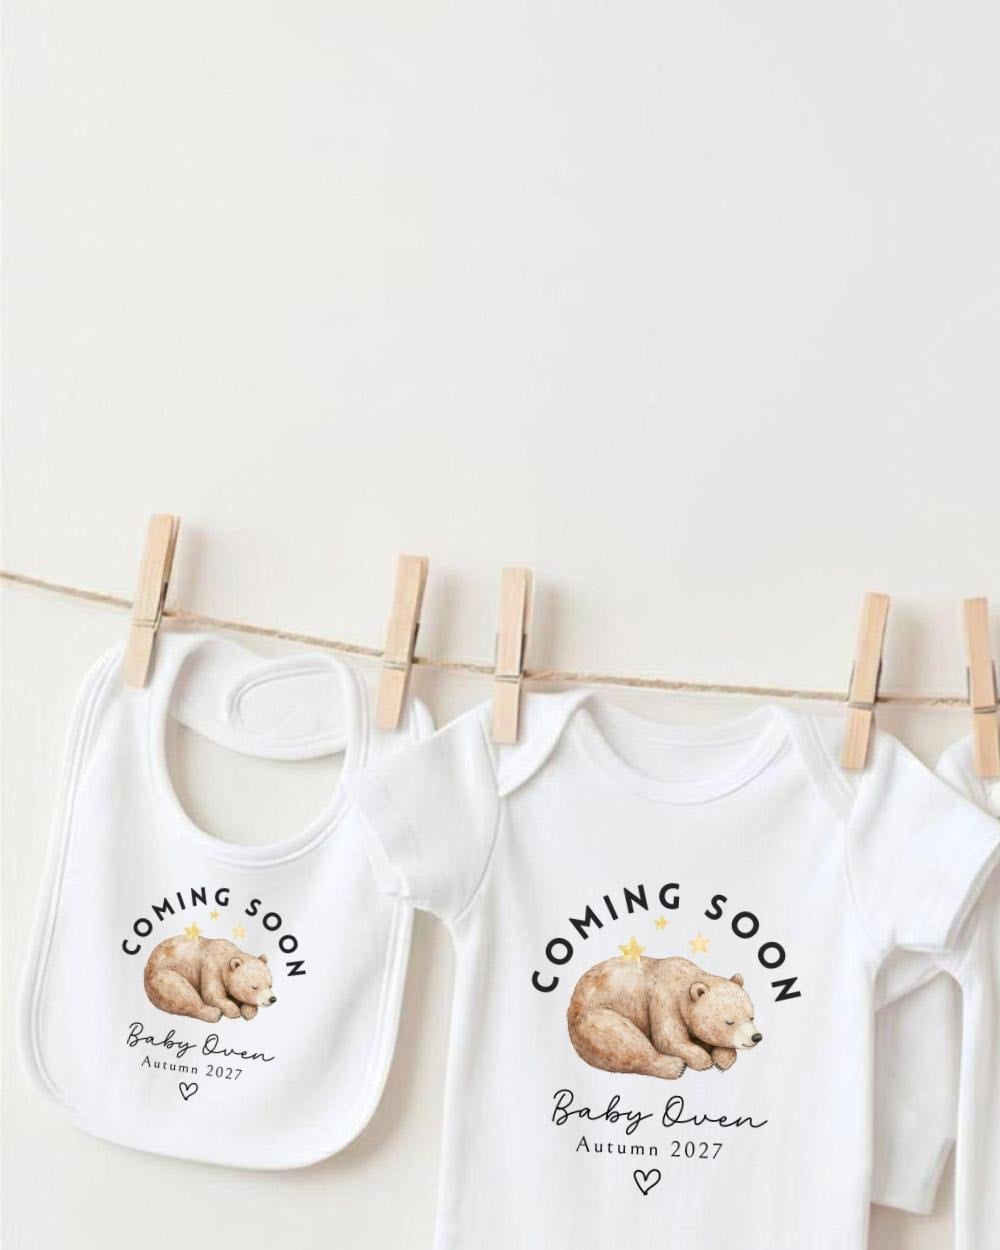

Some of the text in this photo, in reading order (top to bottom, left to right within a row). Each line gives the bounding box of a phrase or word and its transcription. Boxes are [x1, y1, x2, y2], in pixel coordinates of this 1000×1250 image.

[122, 887, 306, 977] COMING SOON
[532, 883, 801, 1002] COMING SOON
[126, 1022, 275, 1062] Baby Oven
[141, 1056, 243, 1080] Autumn 2027
[551, 1089, 768, 1135] Baby Oven
[576, 1136, 724, 1159] Autumn 2027
